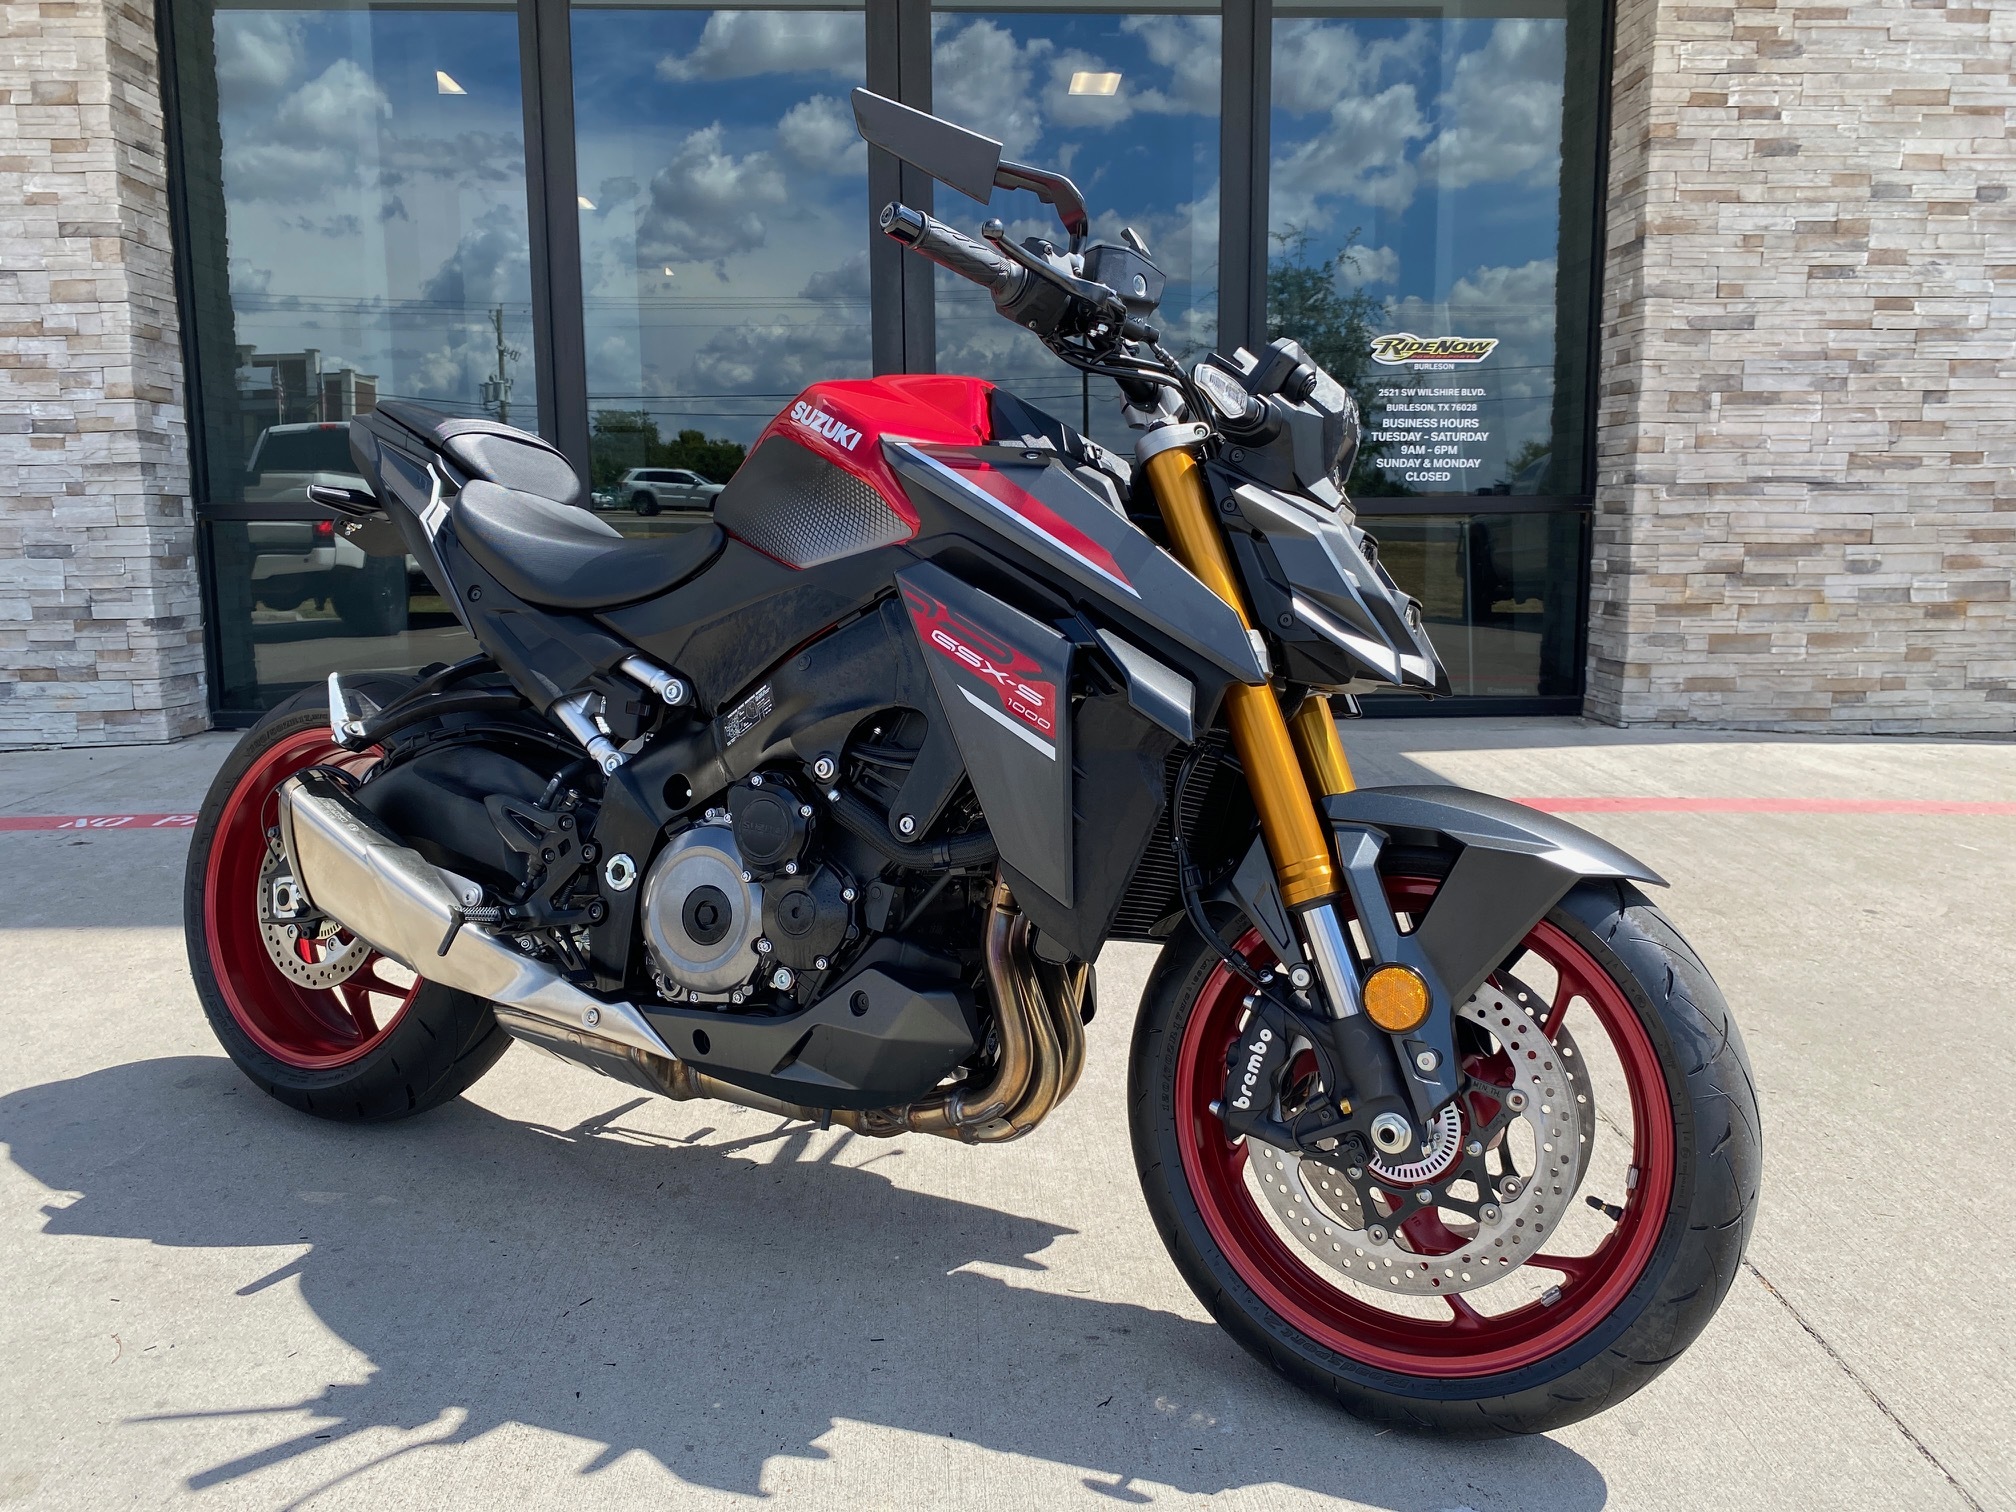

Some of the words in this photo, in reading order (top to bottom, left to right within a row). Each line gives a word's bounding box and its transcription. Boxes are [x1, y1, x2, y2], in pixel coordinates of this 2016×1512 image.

[1413, 363, 1455, 371] BURLESON
[1378, 388, 1399, 397] 2521
[1400, 388, 1416, 397] SW
[1417, 388, 1460, 397] WILSHIRE
[1461, 388, 1486, 397] BLVD.
[1386, 403, 1436, 412] BURLESON,
[1437, 403, 1450, 412] TX
[1451, 403, 1478, 412] 76028
[790, 400, 863, 452] SUZUKI
[1382, 418, 1438, 428] BUSINESS
[1440, 418, 1480, 428] HOURS
[1371, 431, 1422, 442] TUESDAY
[1430, 431, 1490, 442] SATURDAY
[1400, 445, 1426, 455] 9AM
[1434, 445, 1458, 455] 6PM
[1376, 458, 1421, 468] SUNDAY
[1422, 458, 1432, 468] &
[1433, 458, 1482, 468] MONDAY
[1405, 471, 1451, 482] CLOSED
[931, 629, 1045, 707] GSX-S
[1007, 697, 1051, 730] 1000
[1232, 1028, 1272, 1109] brembo
